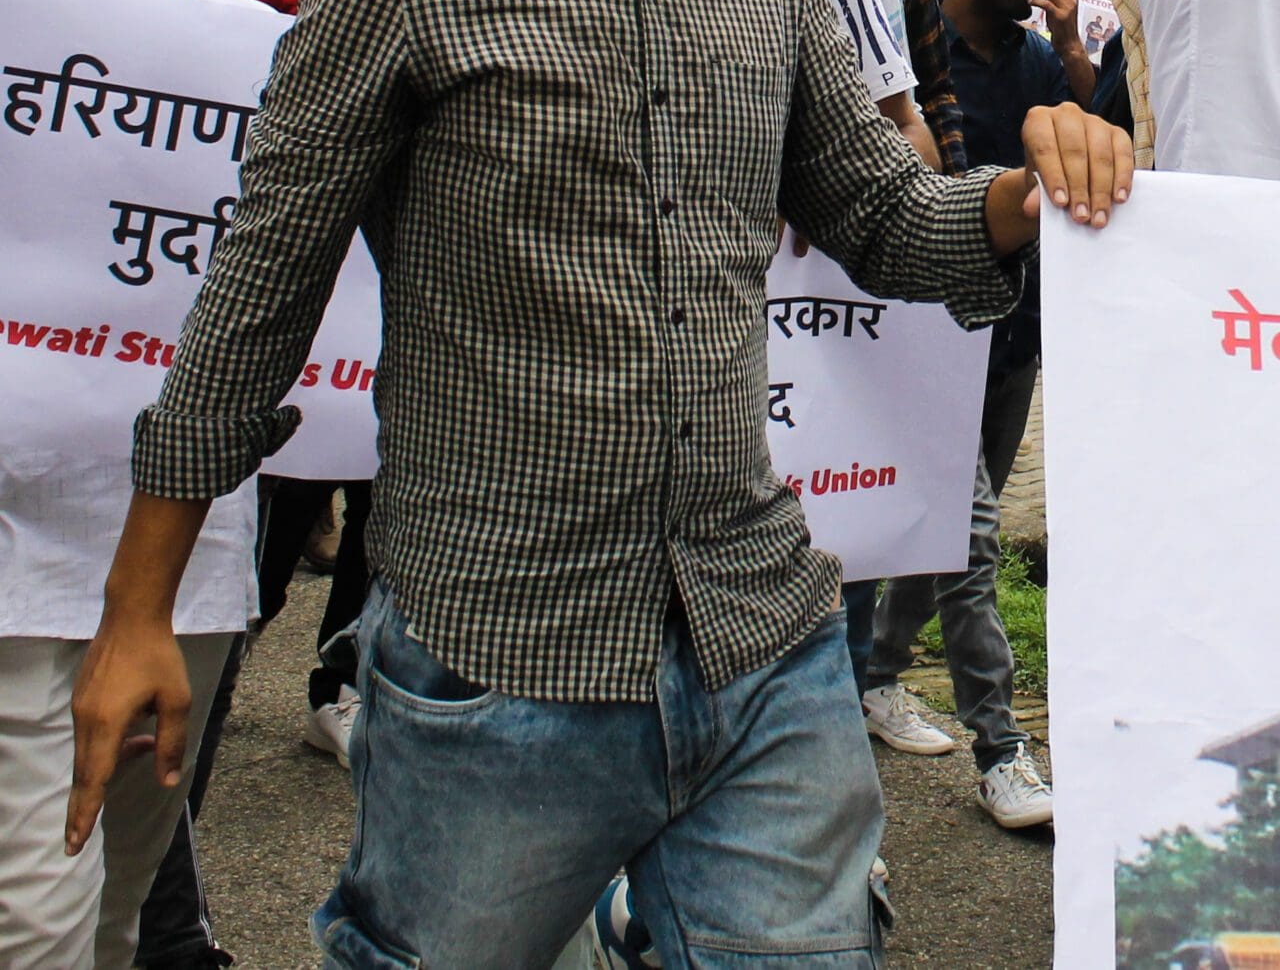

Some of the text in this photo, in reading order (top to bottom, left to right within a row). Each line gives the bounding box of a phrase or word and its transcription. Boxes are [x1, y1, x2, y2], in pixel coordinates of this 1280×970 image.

[2, 53, 257, 161] हरियाण
[0, 319, 111, 358] wati
[764, 296, 888, 340] रकार
[811, 462, 897, 496] Union
